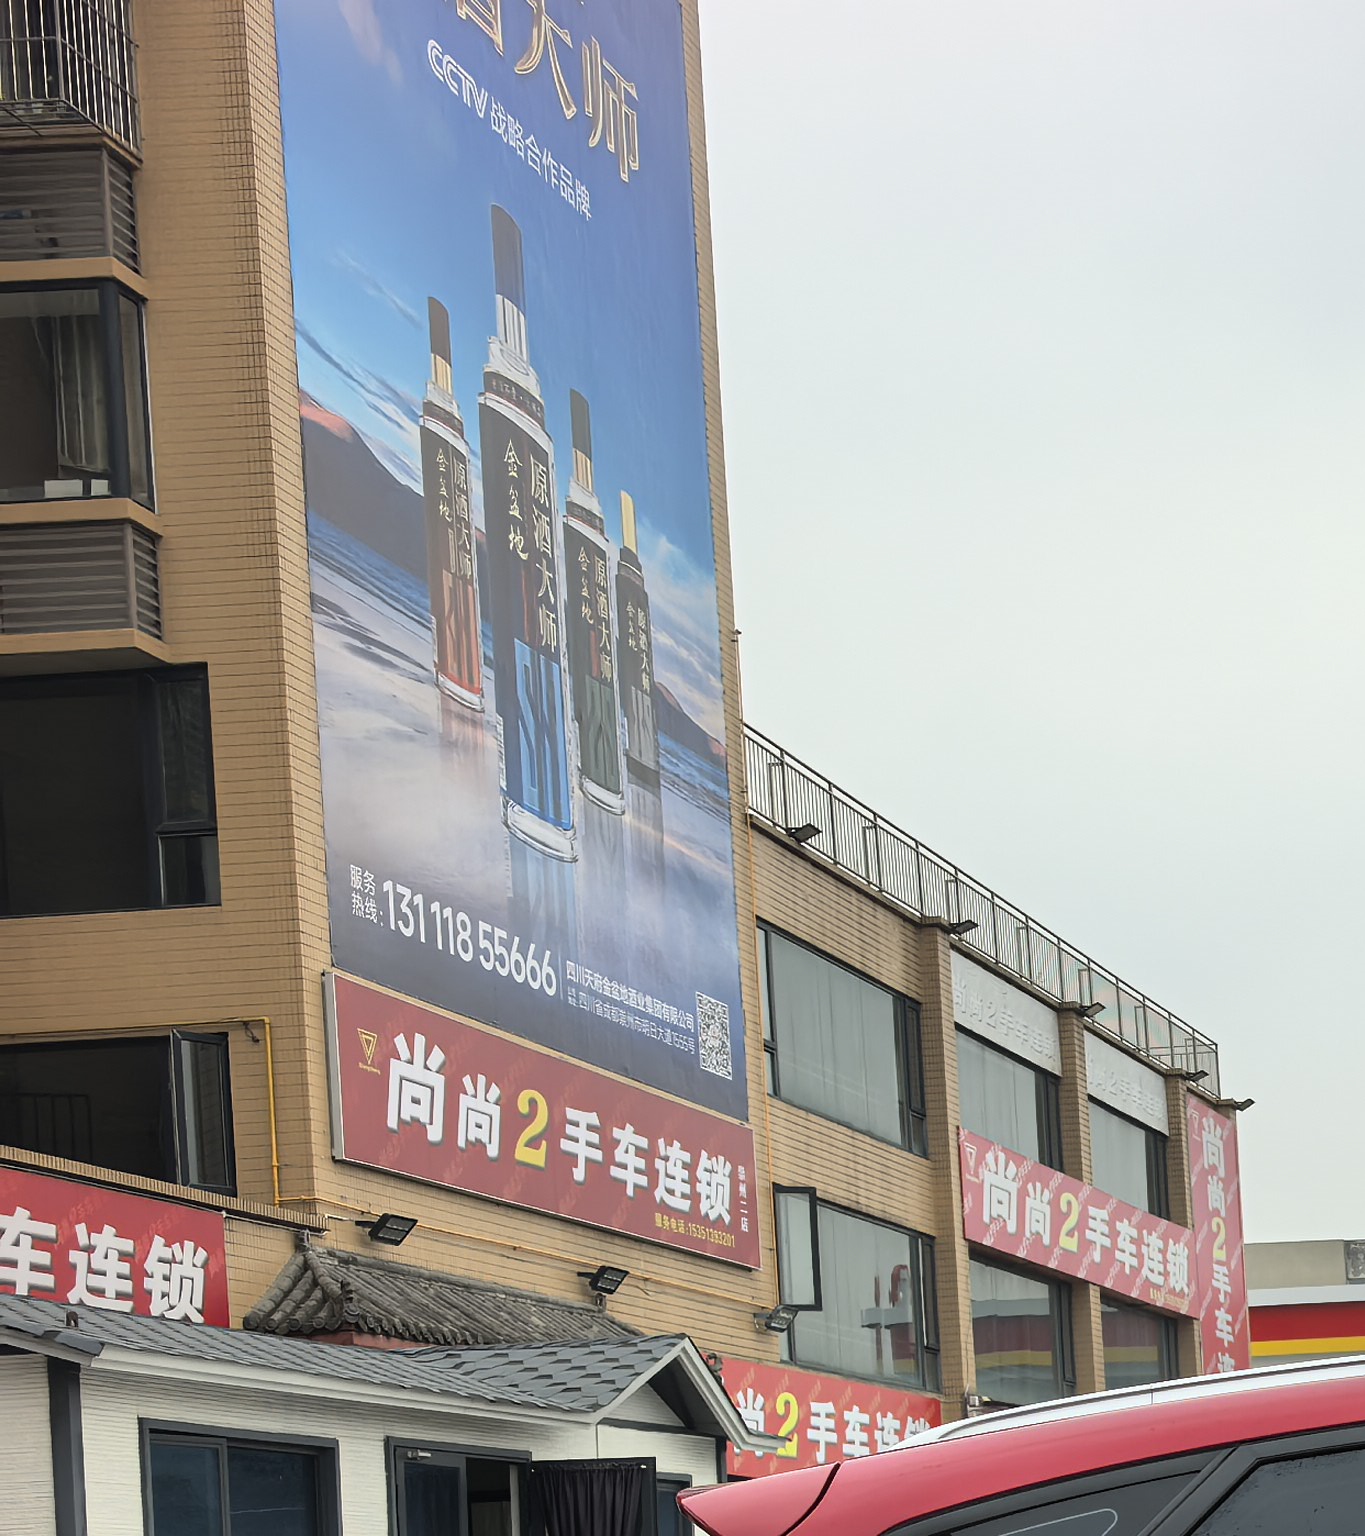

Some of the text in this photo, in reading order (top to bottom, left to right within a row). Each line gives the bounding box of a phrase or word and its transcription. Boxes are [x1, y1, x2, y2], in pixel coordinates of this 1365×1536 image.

[427, 39, 592, 221] CCTV 战略合作品牌
[453, 456, 472, 580] 原酒大师
[530, 452, 557, 653] 原酒大师
[594, 554, 612, 684] 原酒大师
[350, 864, 376, 896] 服务
[387, 1032, 734, 1226] 尚尚2手车连锁
[982, 1149, 1189, 1295] 尚尚2手车连锁
